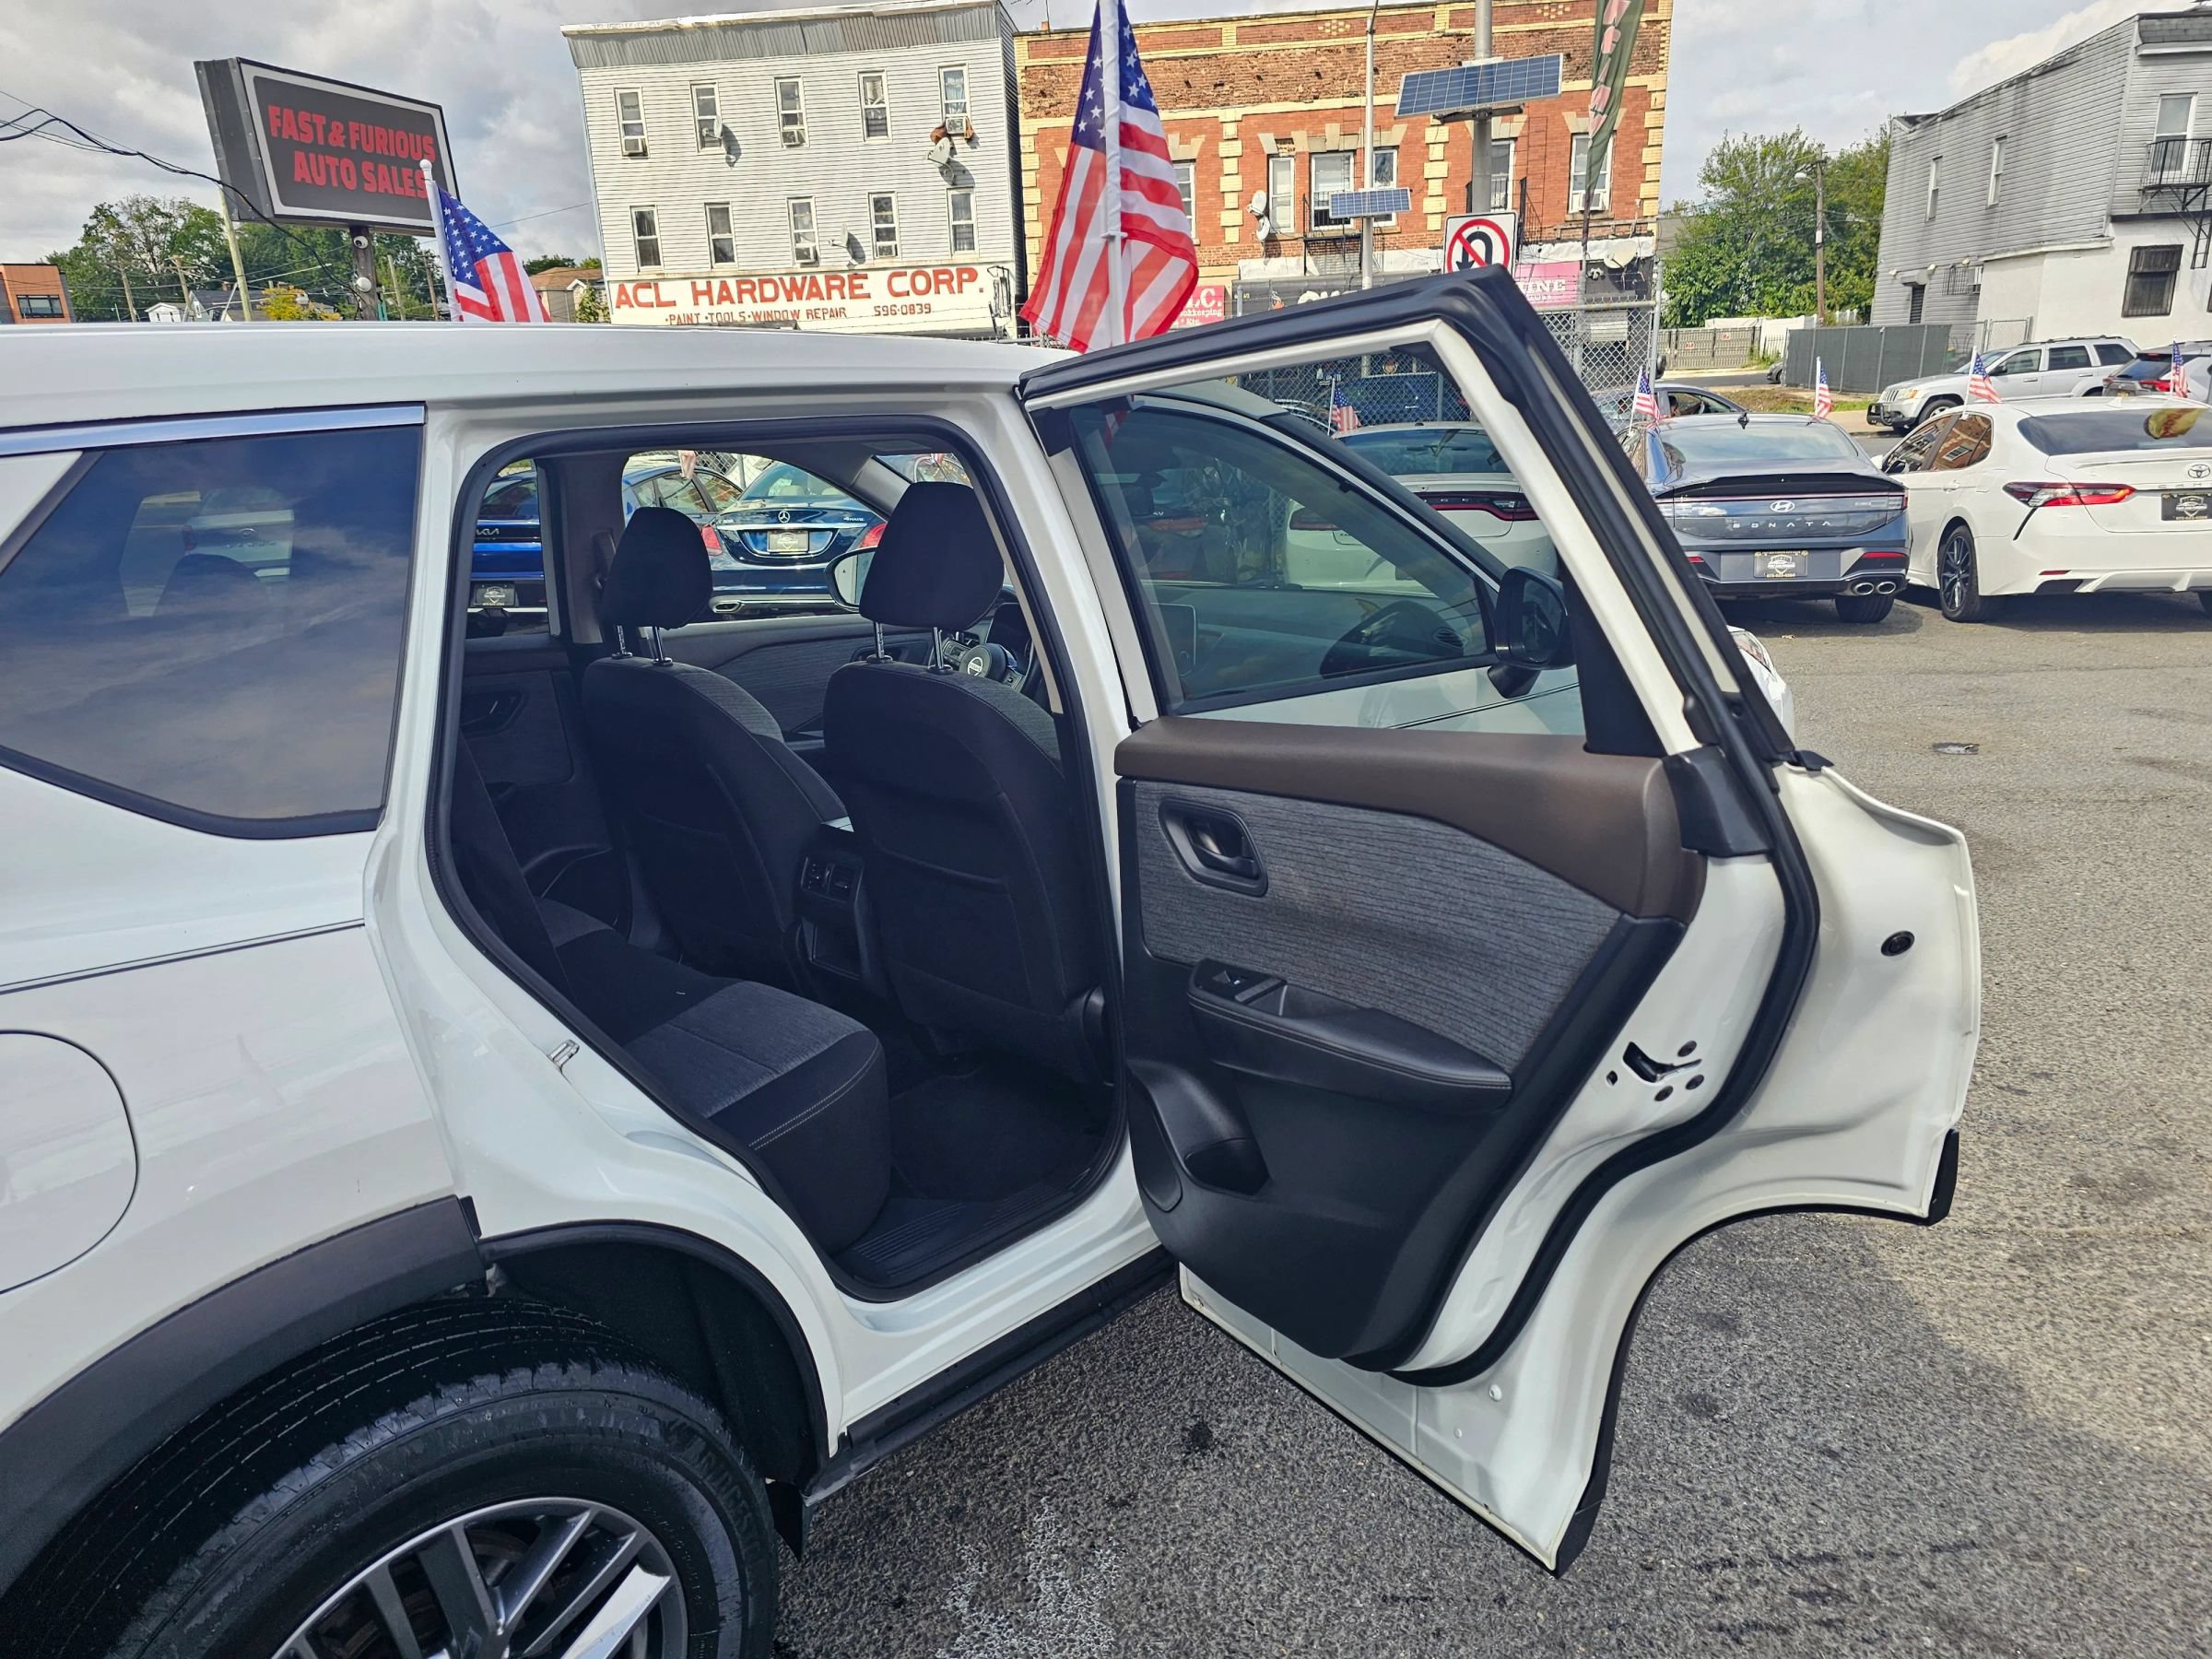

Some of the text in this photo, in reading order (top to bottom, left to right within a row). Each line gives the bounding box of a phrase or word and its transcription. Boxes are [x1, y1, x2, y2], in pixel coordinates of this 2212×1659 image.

[268, 104, 436, 163] FAST & FURIOUS
[293, 149, 429, 199] AUTO SALES
[615, 266, 984, 310] ACL HARDWARE CORP.
[806, 307, 849, 321] REPAIR
[1732, 520, 1831, 529] SONATA
